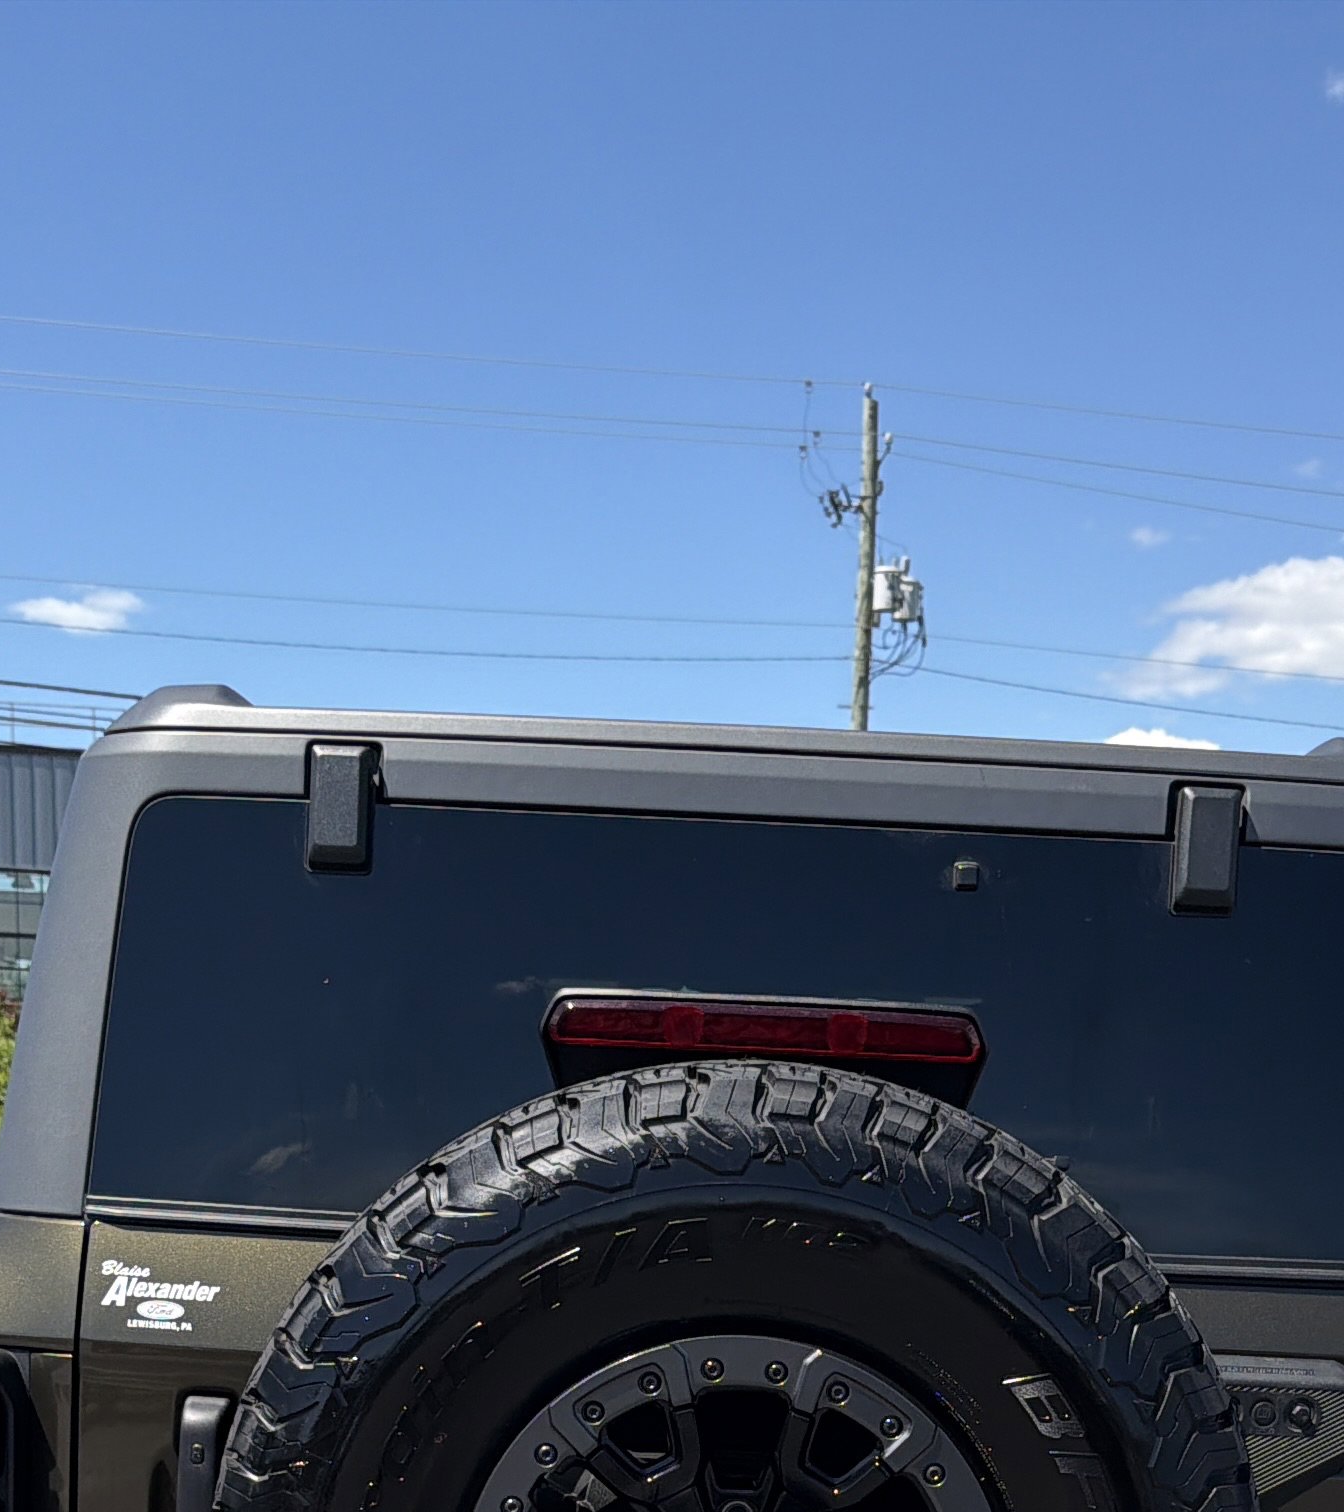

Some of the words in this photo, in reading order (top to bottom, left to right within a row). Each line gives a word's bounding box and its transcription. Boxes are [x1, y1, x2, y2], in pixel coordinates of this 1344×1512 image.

[101, 1259, 151, 1278] Blaise
[100, 1275, 221, 1307] Alexander
[146, 1303, 174, 1316] Ford
[126, 1318, 180, 1332] LEWISBURG,
[180, 1321, 193, 1332] PA
